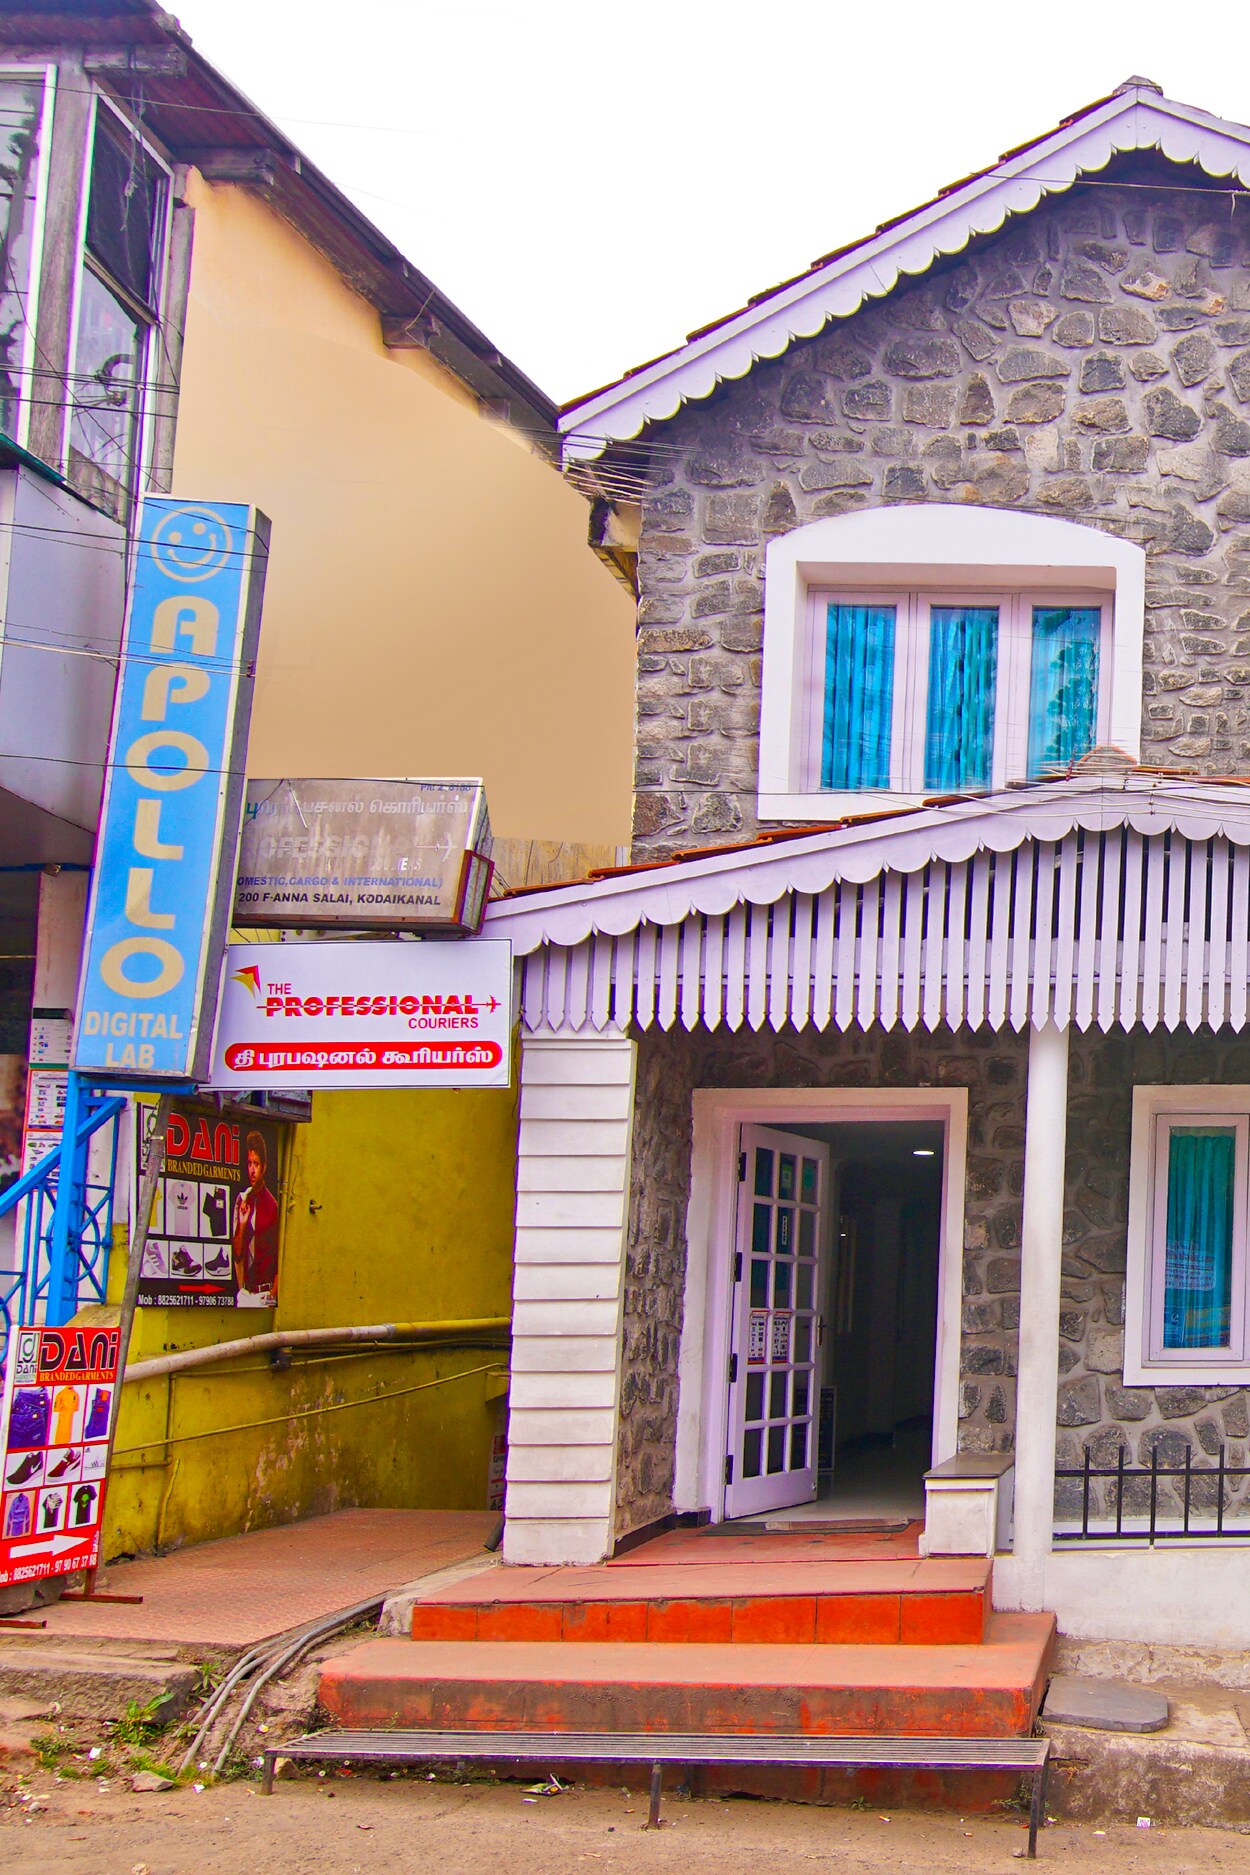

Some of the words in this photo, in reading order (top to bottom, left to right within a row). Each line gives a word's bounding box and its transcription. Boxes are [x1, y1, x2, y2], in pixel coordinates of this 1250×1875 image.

[100, 596, 220, 999] APOLLO
[237, 876, 328, 887] OMESTIC,CARGO
[331, 876, 339, 886] &
[343, 876, 443, 888] INTERNATIONAL)
[238, 892, 259, 902] 200
[313, 893, 353, 905] SALAI,
[357, 894, 441, 905] KODAIKANAL
[267, 983, 292, 995] THE
[265, 994, 479, 1017] PROFESSIONAL
[83, 1010, 183, 1039] DIGITAL
[408, 1017, 479, 1029] COURIERS
[105, 1042, 155, 1069] LAB
[233, 1049, 256, 1069] தி
[167, 1159, 203, 1177] BRANDED
[203, 1163, 241, 1181] GARMENTS
[40, 1372, 75, 1382] BRANDED
[75, 1371, 114, 1380] GARMENTS
